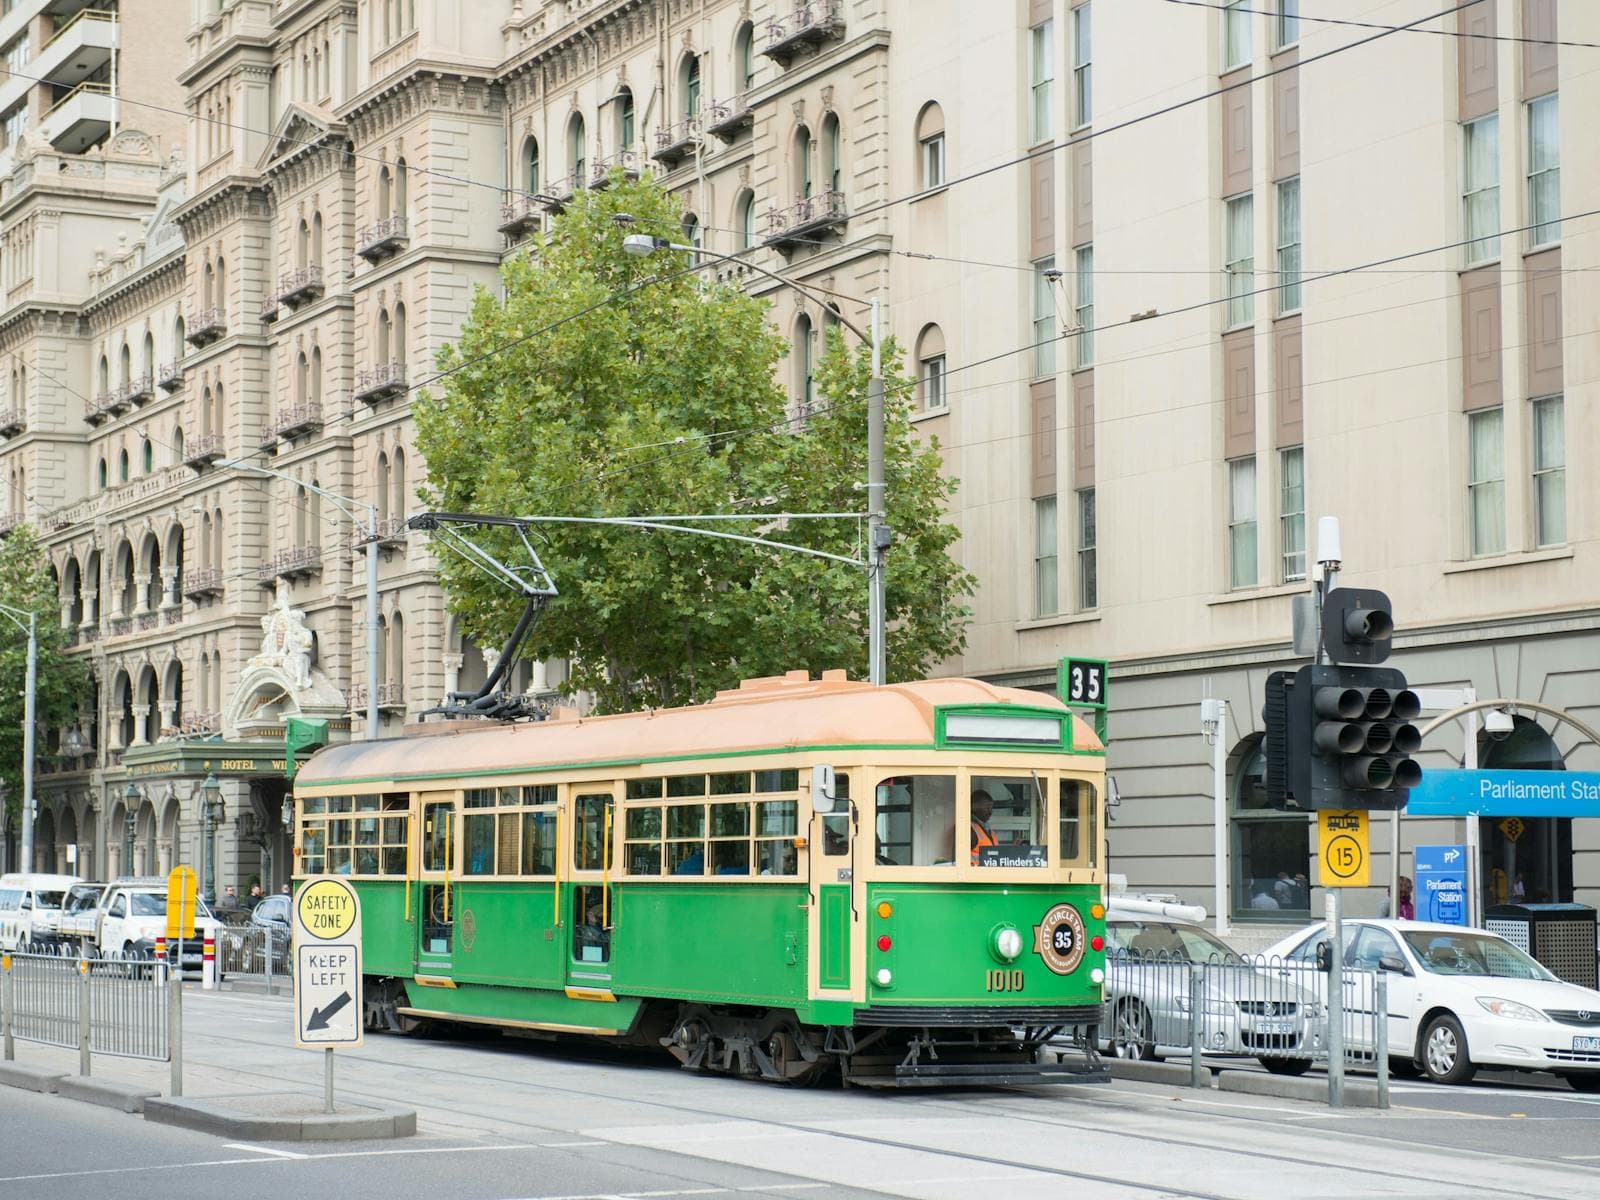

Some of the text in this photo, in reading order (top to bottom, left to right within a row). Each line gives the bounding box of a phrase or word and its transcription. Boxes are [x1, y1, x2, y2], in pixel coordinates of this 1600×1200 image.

[1071, 667, 1100, 700] 35
[221, 760, 306, 771] HOTEL WIDS
[1480, 779, 1600, 800] Parliament Sta
[983, 858, 998, 867] via
[1000, 857, 1034, 867] Flinders
[1337, 847, 1353, 867] 15
[1426, 879, 1462, 890] Parliament
[307, 895, 348, 910] SAFETY
[1438, 892, 1462, 903] Station
[313, 914, 342, 929] ZONE
[1043, 911, 1082, 951] CITY CIRCLE TRAM
[1055, 931, 1072, 949] 35
[309, 955, 347, 968] KEEP
[311, 973, 346, 986] LEFT
[986, 970, 1024, 992] 1010
